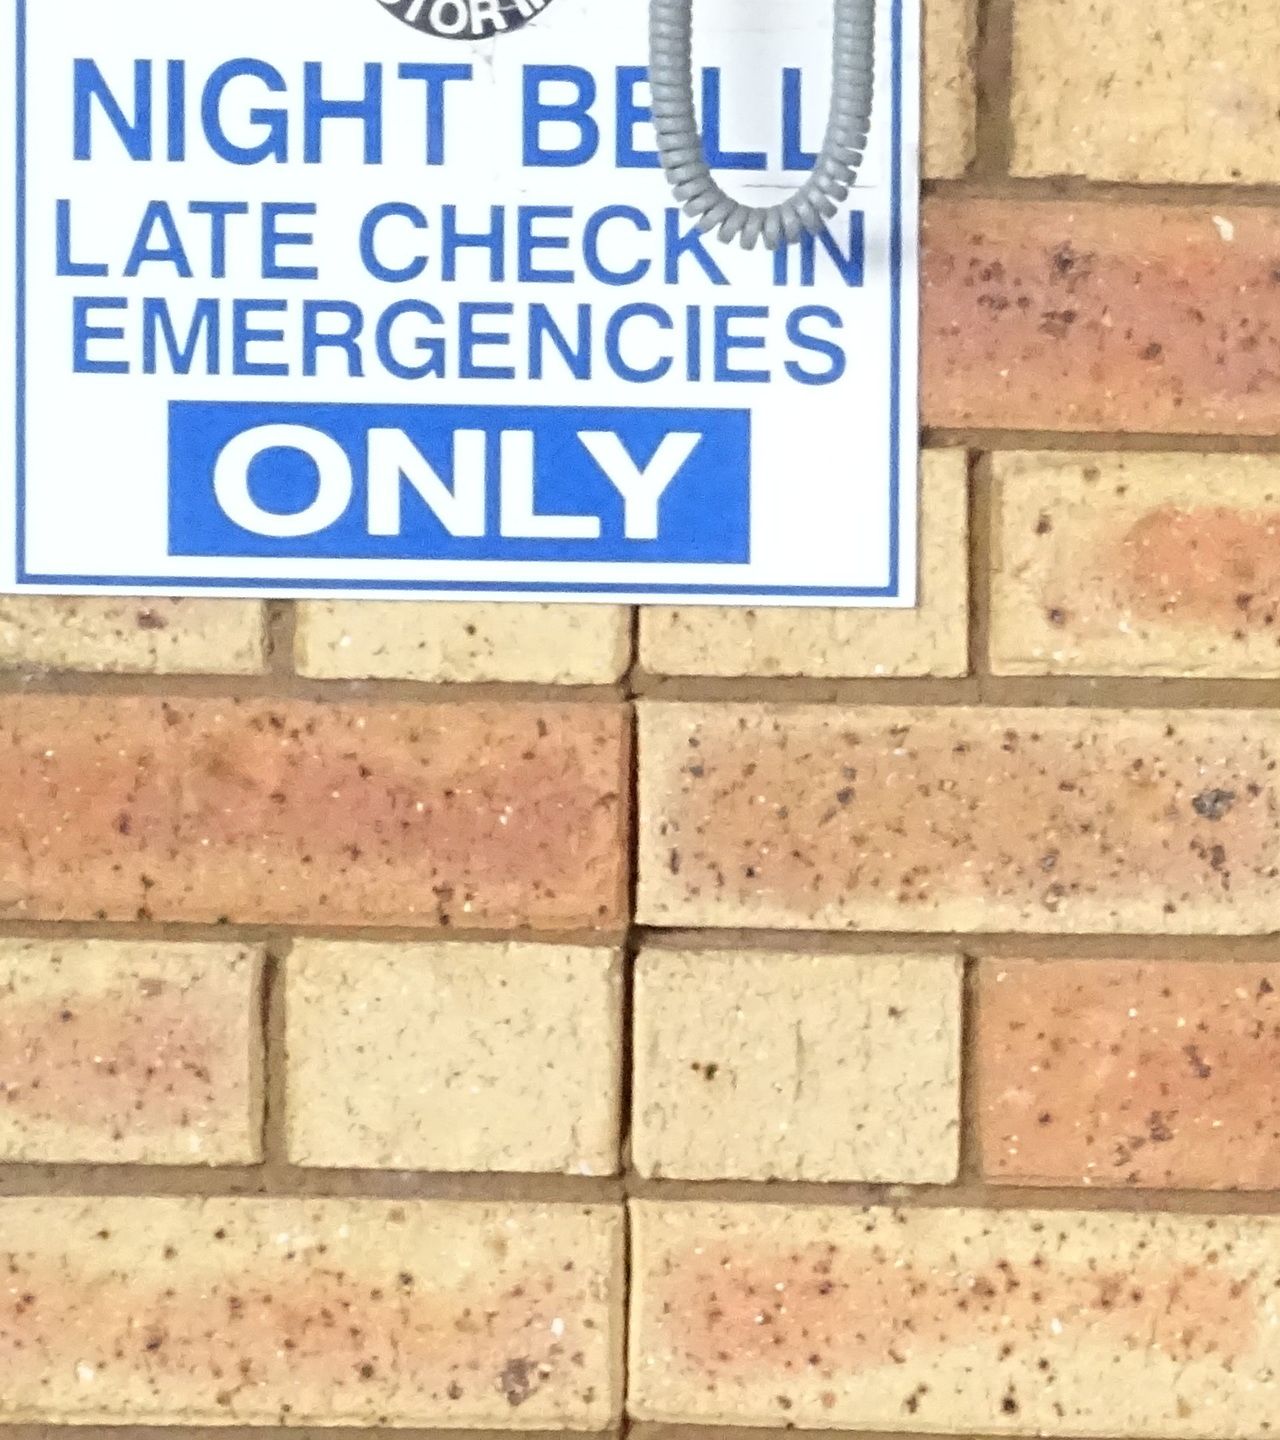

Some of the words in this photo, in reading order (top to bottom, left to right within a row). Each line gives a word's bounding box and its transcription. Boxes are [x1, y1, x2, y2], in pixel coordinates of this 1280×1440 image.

[72, 58, 472, 166] NIGHT
[521, 65, 860, 172] BELL
[54, 198, 320, 280] LATE
[358, 203, 731, 286] CHECK
[772, 208, 866, 288] IN
[72, 296, 847, 386] EMERGENCIES
[213, 422, 702, 539] ONLY
